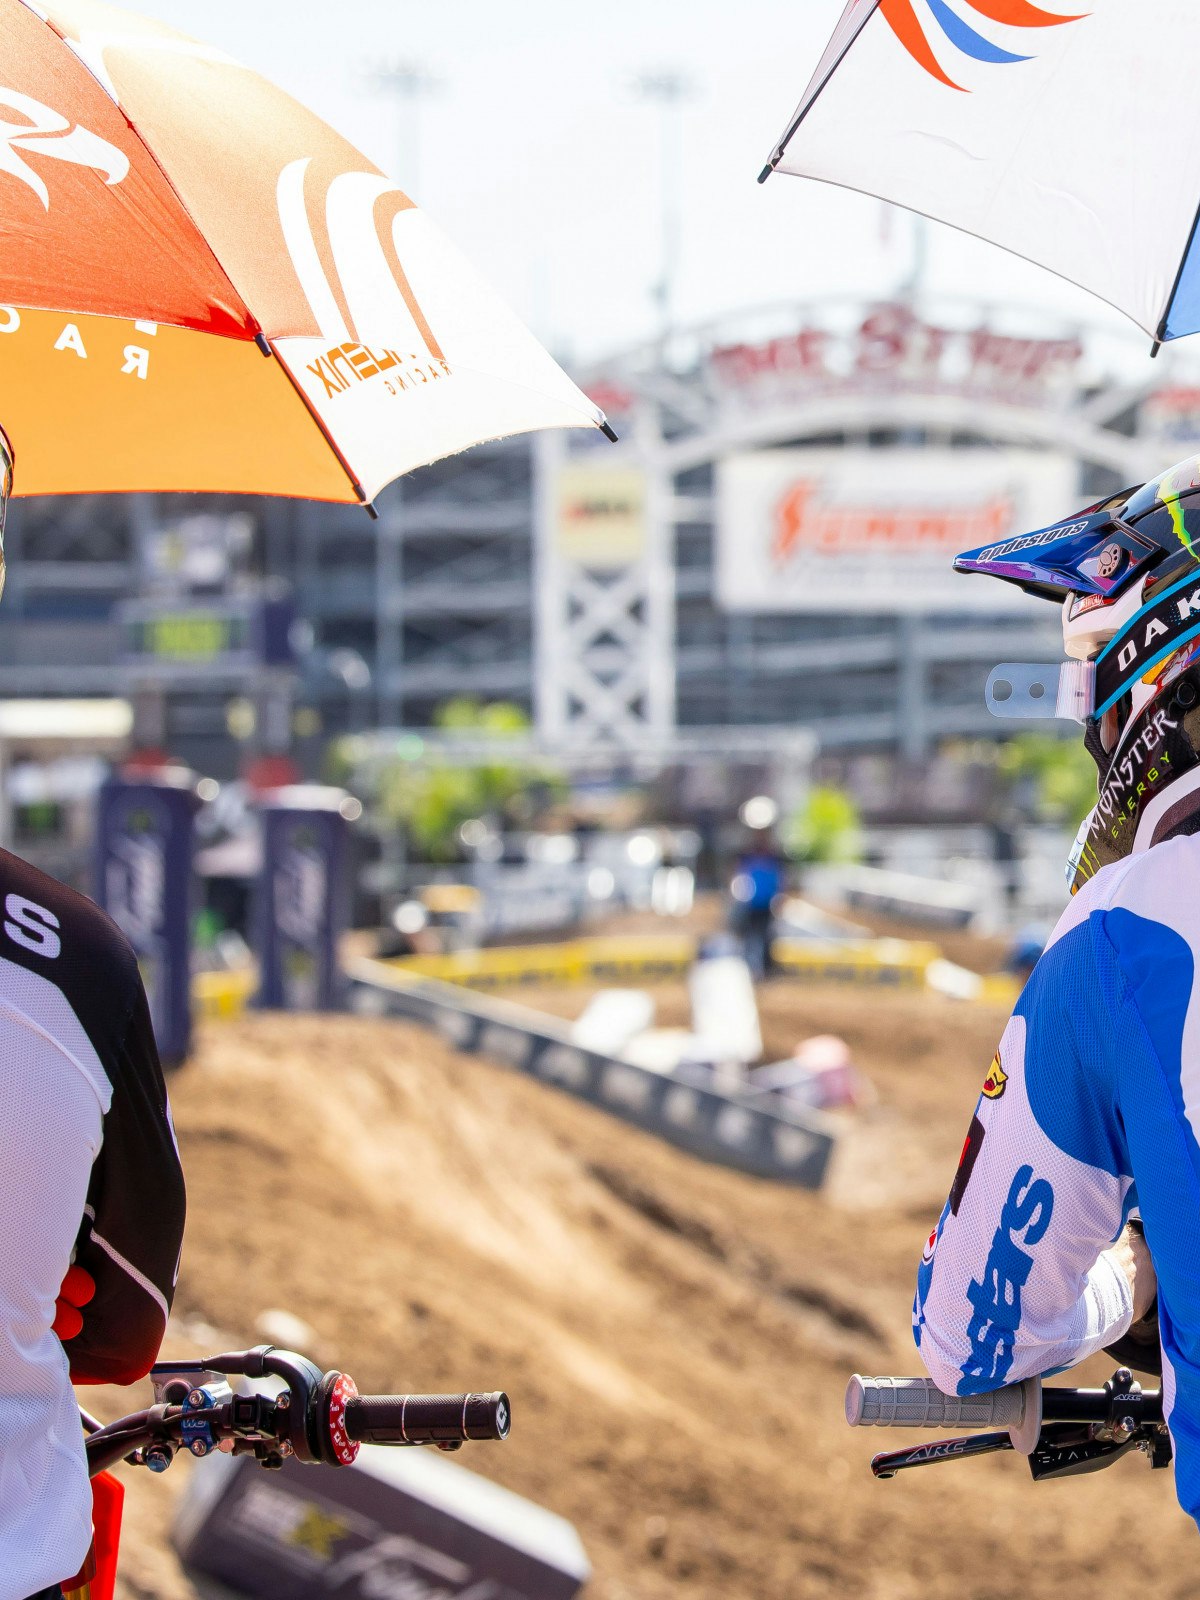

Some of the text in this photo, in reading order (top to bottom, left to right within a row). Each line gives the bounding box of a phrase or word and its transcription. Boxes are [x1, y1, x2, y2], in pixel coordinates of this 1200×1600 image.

[976, 521, 1089, 564] apdesigns
[1089, 707, 1178, 839] MONSTER
[1111, 750, 1172, 839] ENERGY
[905, 1440, 968, 1462] ARC
